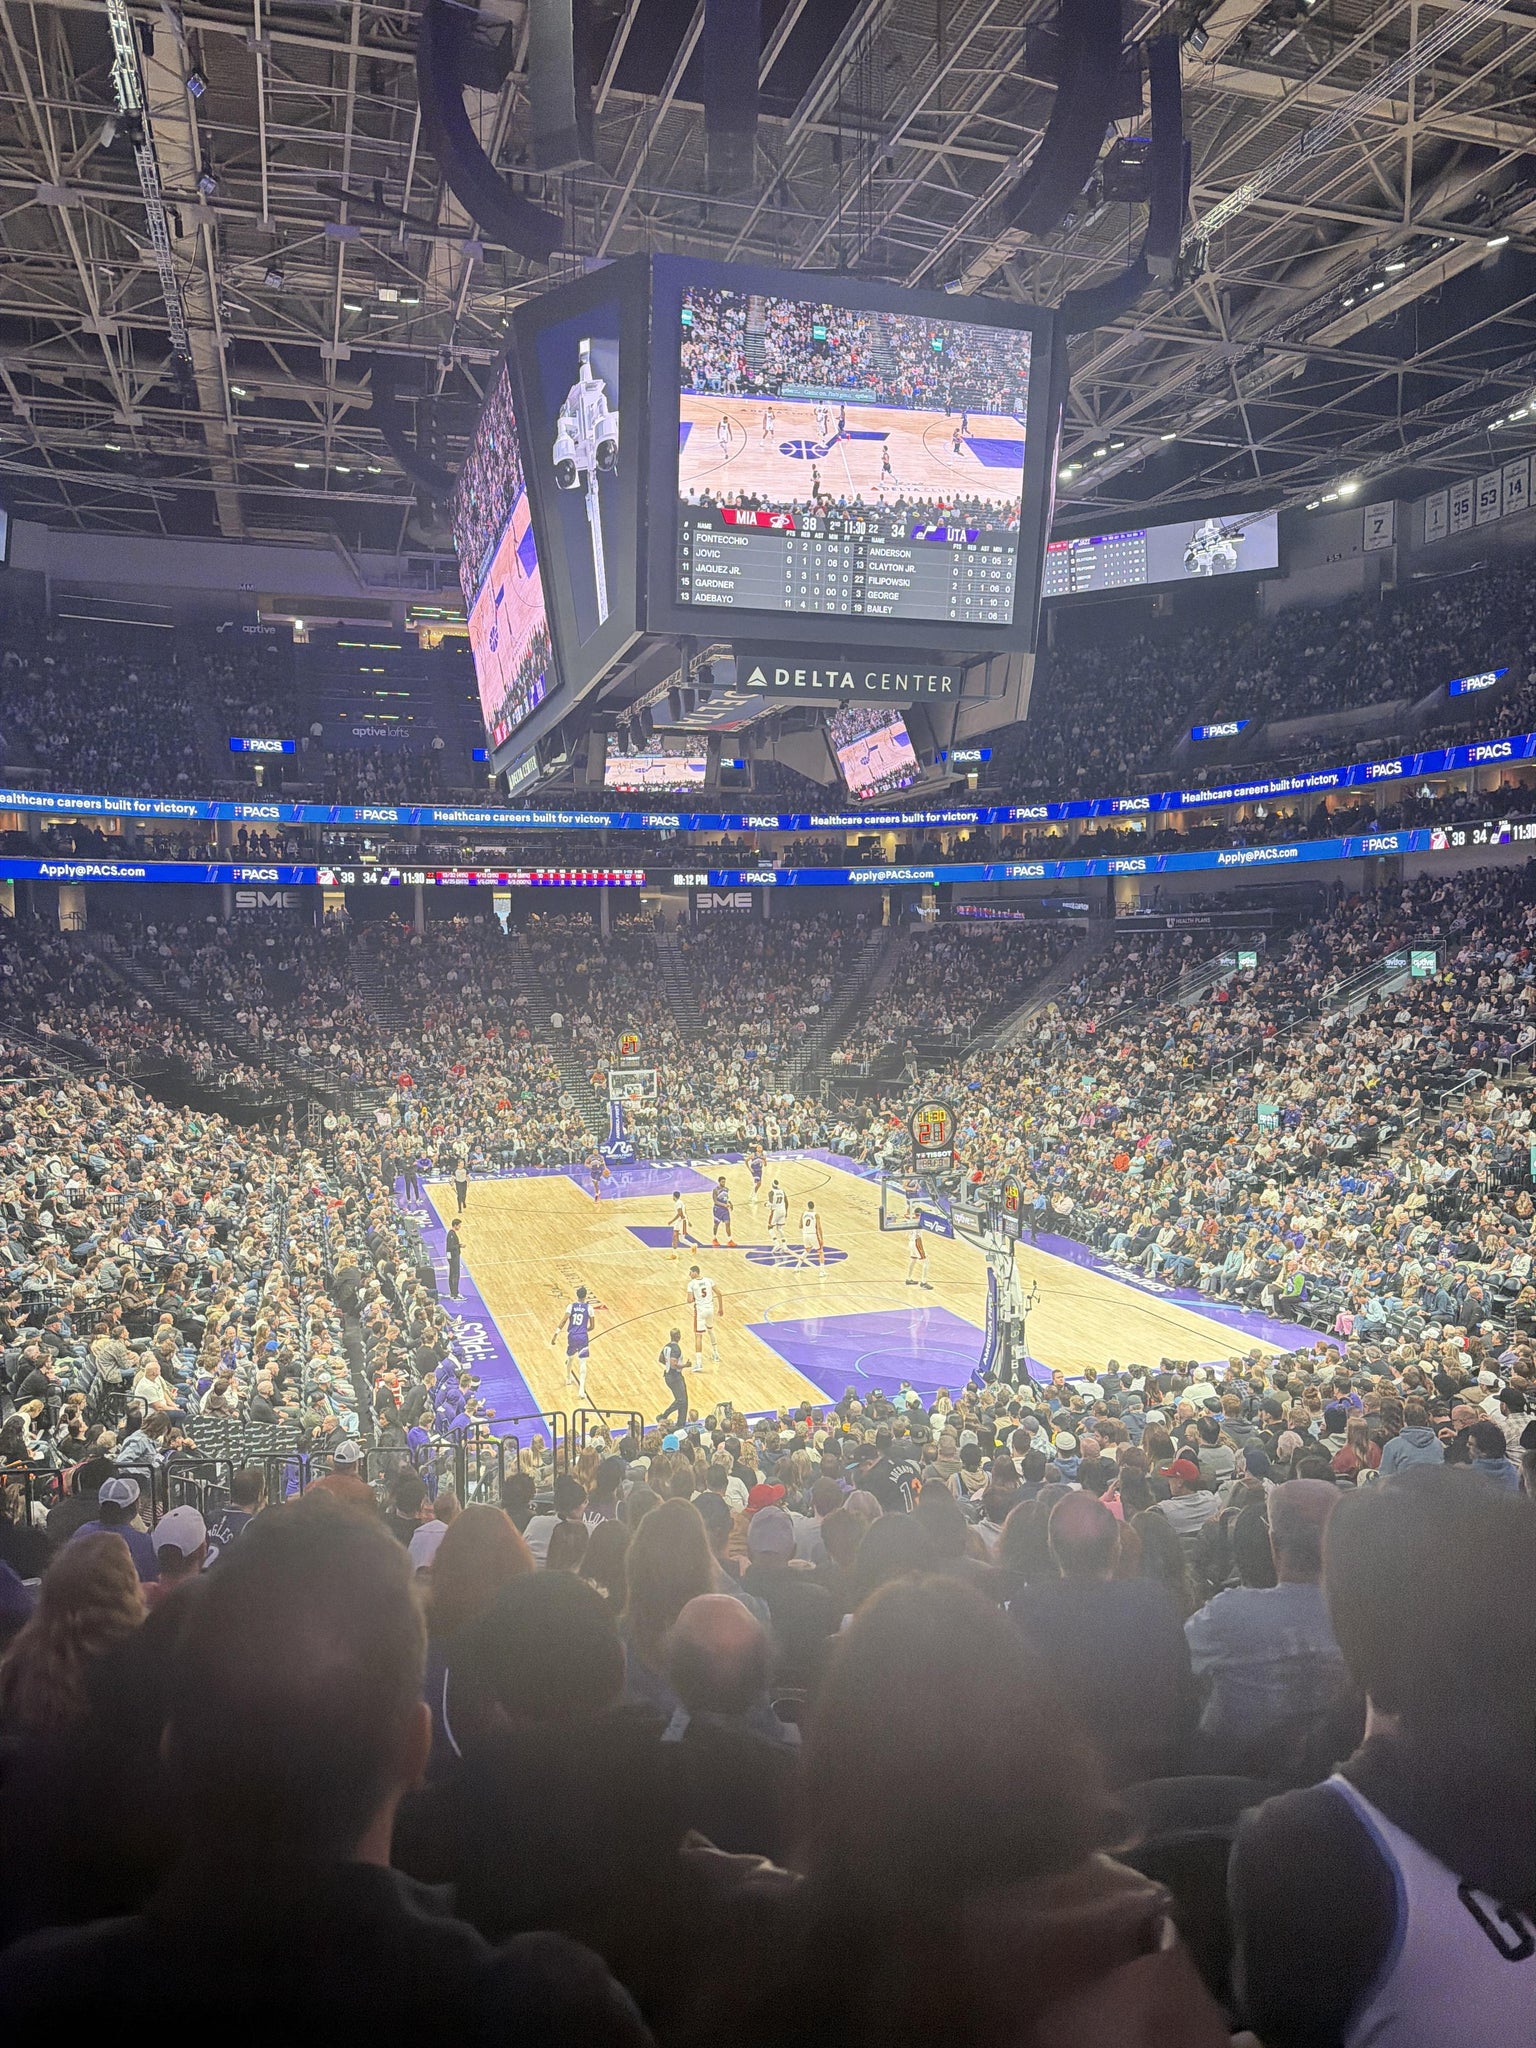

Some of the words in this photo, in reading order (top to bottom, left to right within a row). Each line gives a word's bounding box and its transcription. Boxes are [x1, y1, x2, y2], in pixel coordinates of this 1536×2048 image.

[1510, 479, 1522, 496] 14
[1481, 489, 1497, 506] 53
[1454, 501, 1468, 516] 35
[736, 512, 757, 524] MIA
[803, 517, 816, 530] 38
[1433, 511, 1437, 524] 1
[844, 521, 865, 534] 11:30
[869, 524, 878, 533] 22
[892, 525, 905, 537] 34
[1374, 519, 1383, 533] 7
[947, 528, 966, 542] UTA
[696, 534, 748, 545] FONTECCHIO
[828, 545, 838, 553] 04
[844, 546, 849, 554] 0
[696, 549, 720, 558] JOVIC
[870, 549, 911, 558] ANDERSON
[696, 564, 727, 574] JAQUEZ
[729, 567, 741, 575] JR.
[869, 562, 904, 572] CLAYTON
[991, 571, 1000, 579] 00
[696, 579, 734, 589] GARDNER
[826, 588, 836, 596] 00
[869, 577, 910, 586] FILIPOWSKI
[681, 592, 689, 600] 13
[695, 593, 733, 603] ADEBAYO
[868, 591, 899, 600] GEORGE
[867, 606, 892, 614] BAILEY
[242, 625, 276, 634] aptive
[775, 669, 854, 688] DELTA
[865, 673, 952, 692] CENTER
[1467, 674, 1496, 690] PACS
[352, 727, 386, 737] aptive
[388, 727, 409, 737] lofts
[1209, 724, 1238, 736] PACS
[251, 741, 283, 750] PACS
[1477, 743, 1511, 760] PACS
[954, 751, 981, 760] PACS
[1373, 762, 1402, 777] PACS
[1182, 789, 1232, 803] Healthcare
[1234, 785, 1268, 797] careers
[1270, 780, 1290, 792] built
[1292, 777, 1304, 788] for
[1306, 773, 1339, 787] victory.
[0, 793, 54, 806] ealthcare
[57, 797, 101, 809] careers
[105, 801, 132, 811] built
[134, 801, 150, 811] for
[153, 802, 197, 816] victory.
[1120, 798, 1149, 810] PACS
[243, 807, 280, 817] PACS
[363, 810, 398, 820] PACS
[433, 811, 490, 821] Healthcare
[493, 813, 530, 822] careers
[533, 811, 556, 822] built
[558, 812, 572, 823] for
[575, 813, 611, 825] victory.
[1017, 808, 1048, 818] PACS
[650, 816, 679, 826] PACS
[749, 817, 779, 827] PACS
[811, 816, 862, 825] Healthcare
[864, 815, 900, 824] careers
[902, 814, 924, 823] built
[926, 813, 940, 822] for
[942, 812, 978, 823] victory.
[1473, 829, 1487, 843] 34
[1513, 824, 1536, 840] 11:30
[1369, 837, 1398, 850] PACS
[1452, 831, 1465, 846] 38
[1218, 848, 1297, 864] Apply@PACS.com
[40, 864, 145, 877] Apply@PACS.com
[1013, 866, 1044, 876] PACS
[1116, 860, 1146, 871] PACS
[242, 870, 278, 880] PACS
[341, 872, 355, 883] 38
[363, 872, 377, 883] 34
[403, 872, 424, 884] 11:30
[696, 875, 707, 885] PM
[747, 873, 776, 882] PACS
[849, 870, 934, 881] Apply@PACS.com
[236, 892, 299, 908] SME
[697, 893, 752, 908] SME
[919, 1123, 944, 1144] 21
[702, 1288, 706, 1297] 5
[573, 1313, 583, 1325] 19
[983, 1321, 992, 1365] AMERICA
